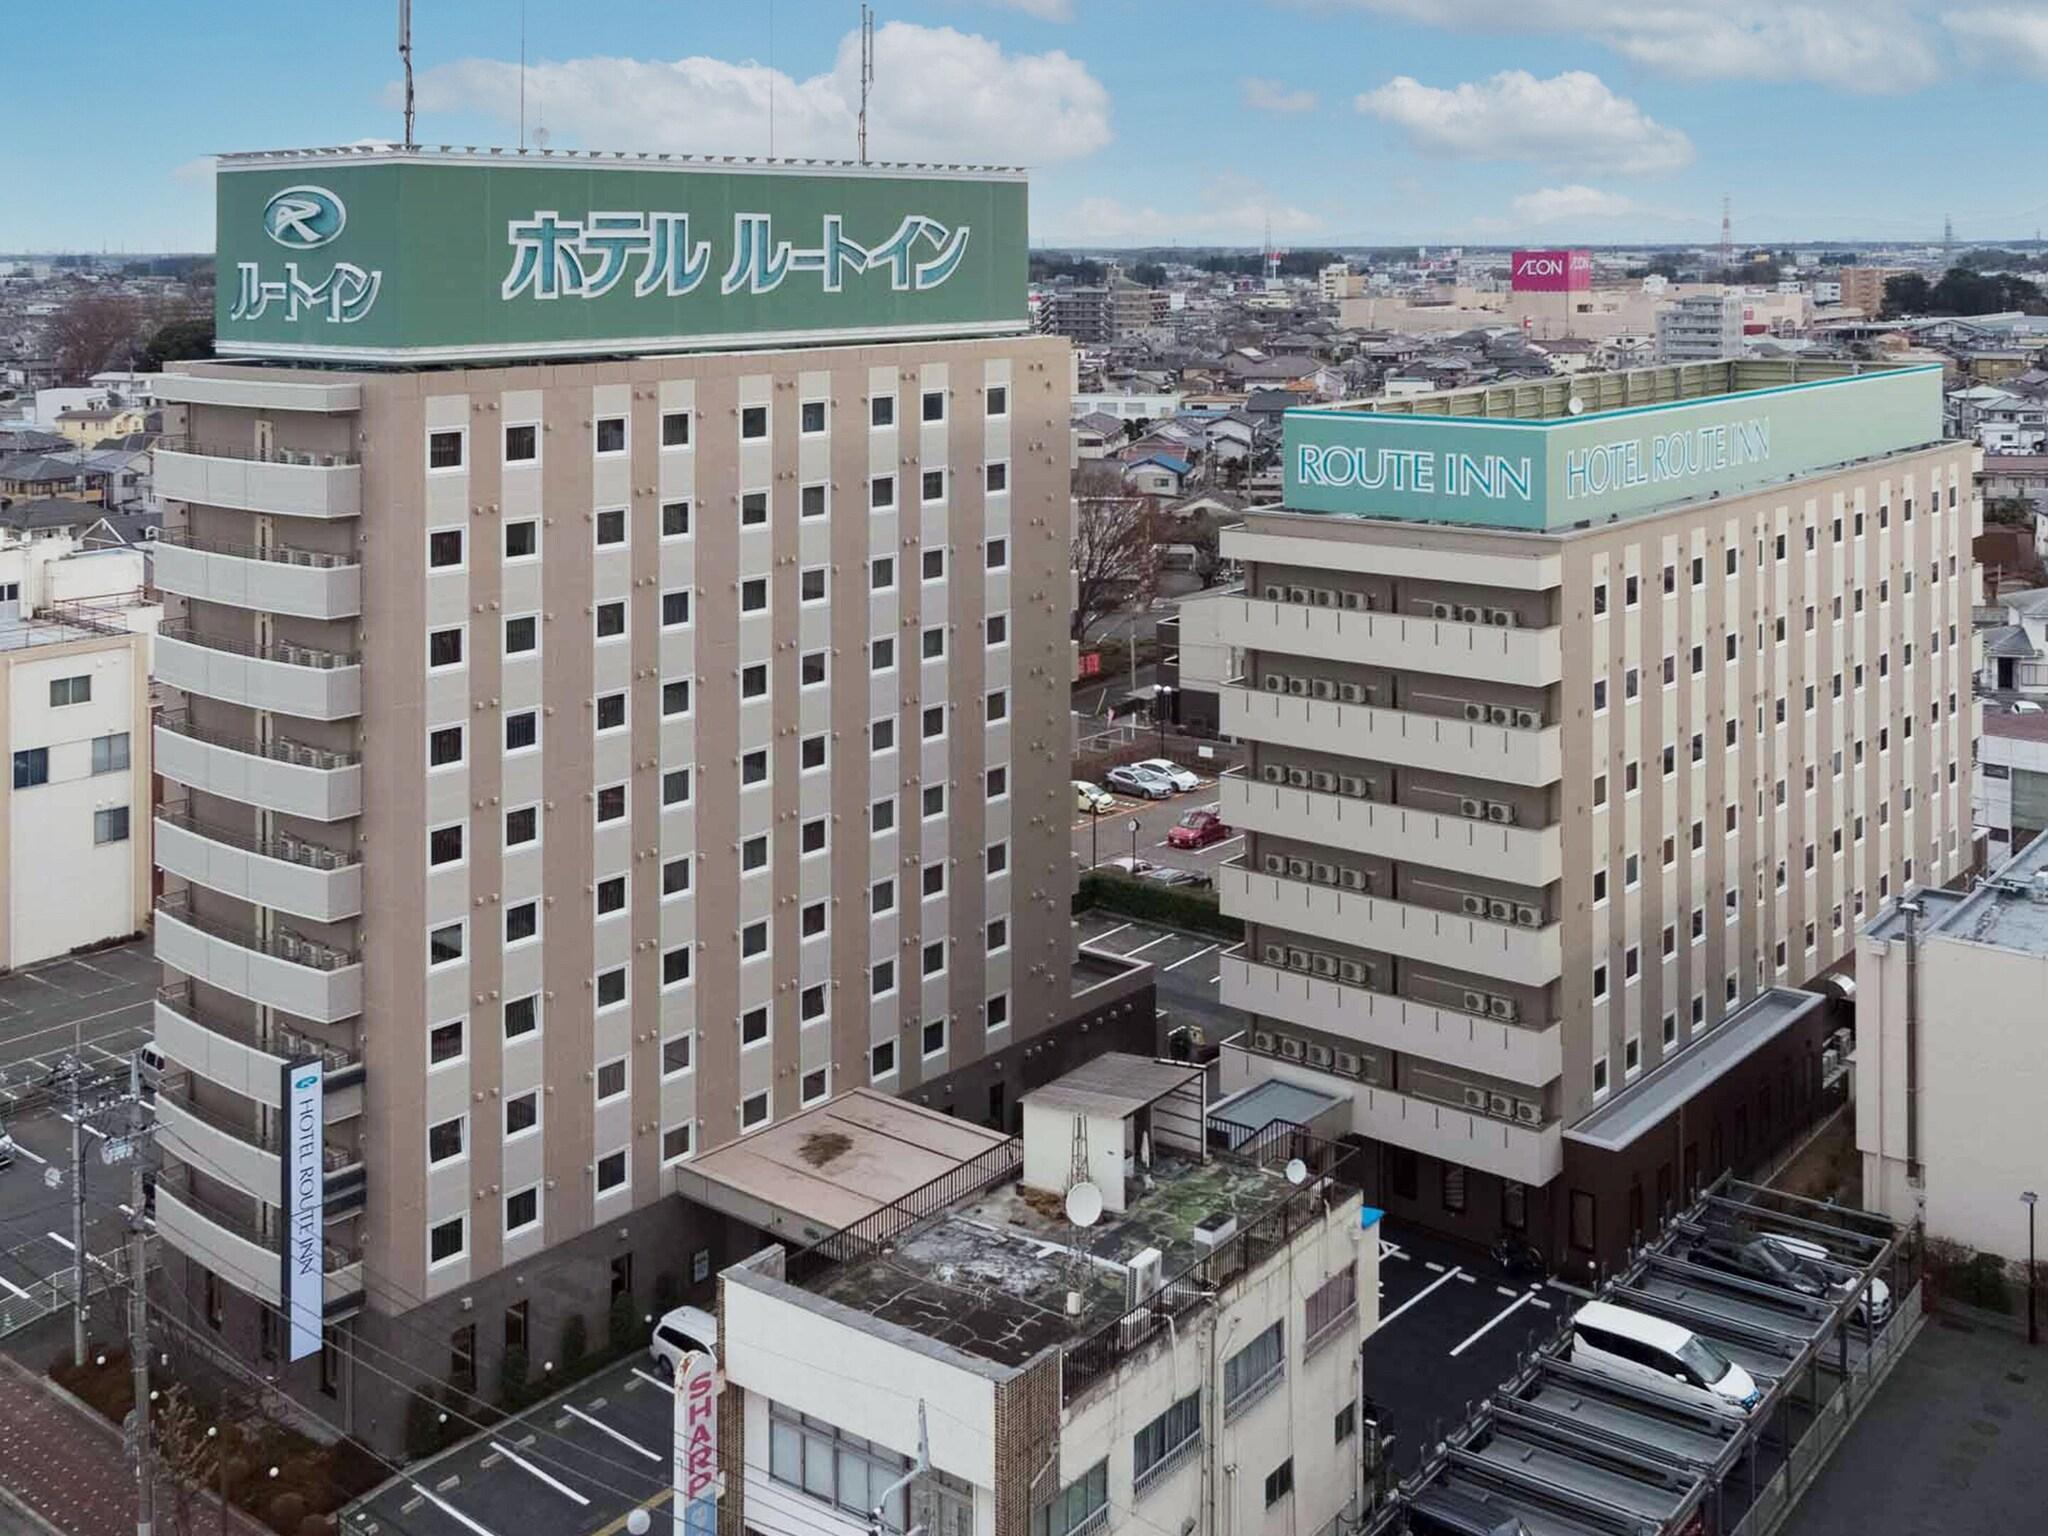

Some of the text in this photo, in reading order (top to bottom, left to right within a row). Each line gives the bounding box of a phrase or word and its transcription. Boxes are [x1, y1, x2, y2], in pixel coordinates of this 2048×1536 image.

[230, 262, 383, 323] ルートイン
[502, 211, 970, 300] ホテル ルートイン
[1298, 444, 1531, 500] ROUTE INN
[1567, 416, 1770, 500] HOTEL ROUTE INN
[299, 1098, 315, 1276] HOTEL ROUTE INN
[689, 1371, 711, 1501] SHARP
